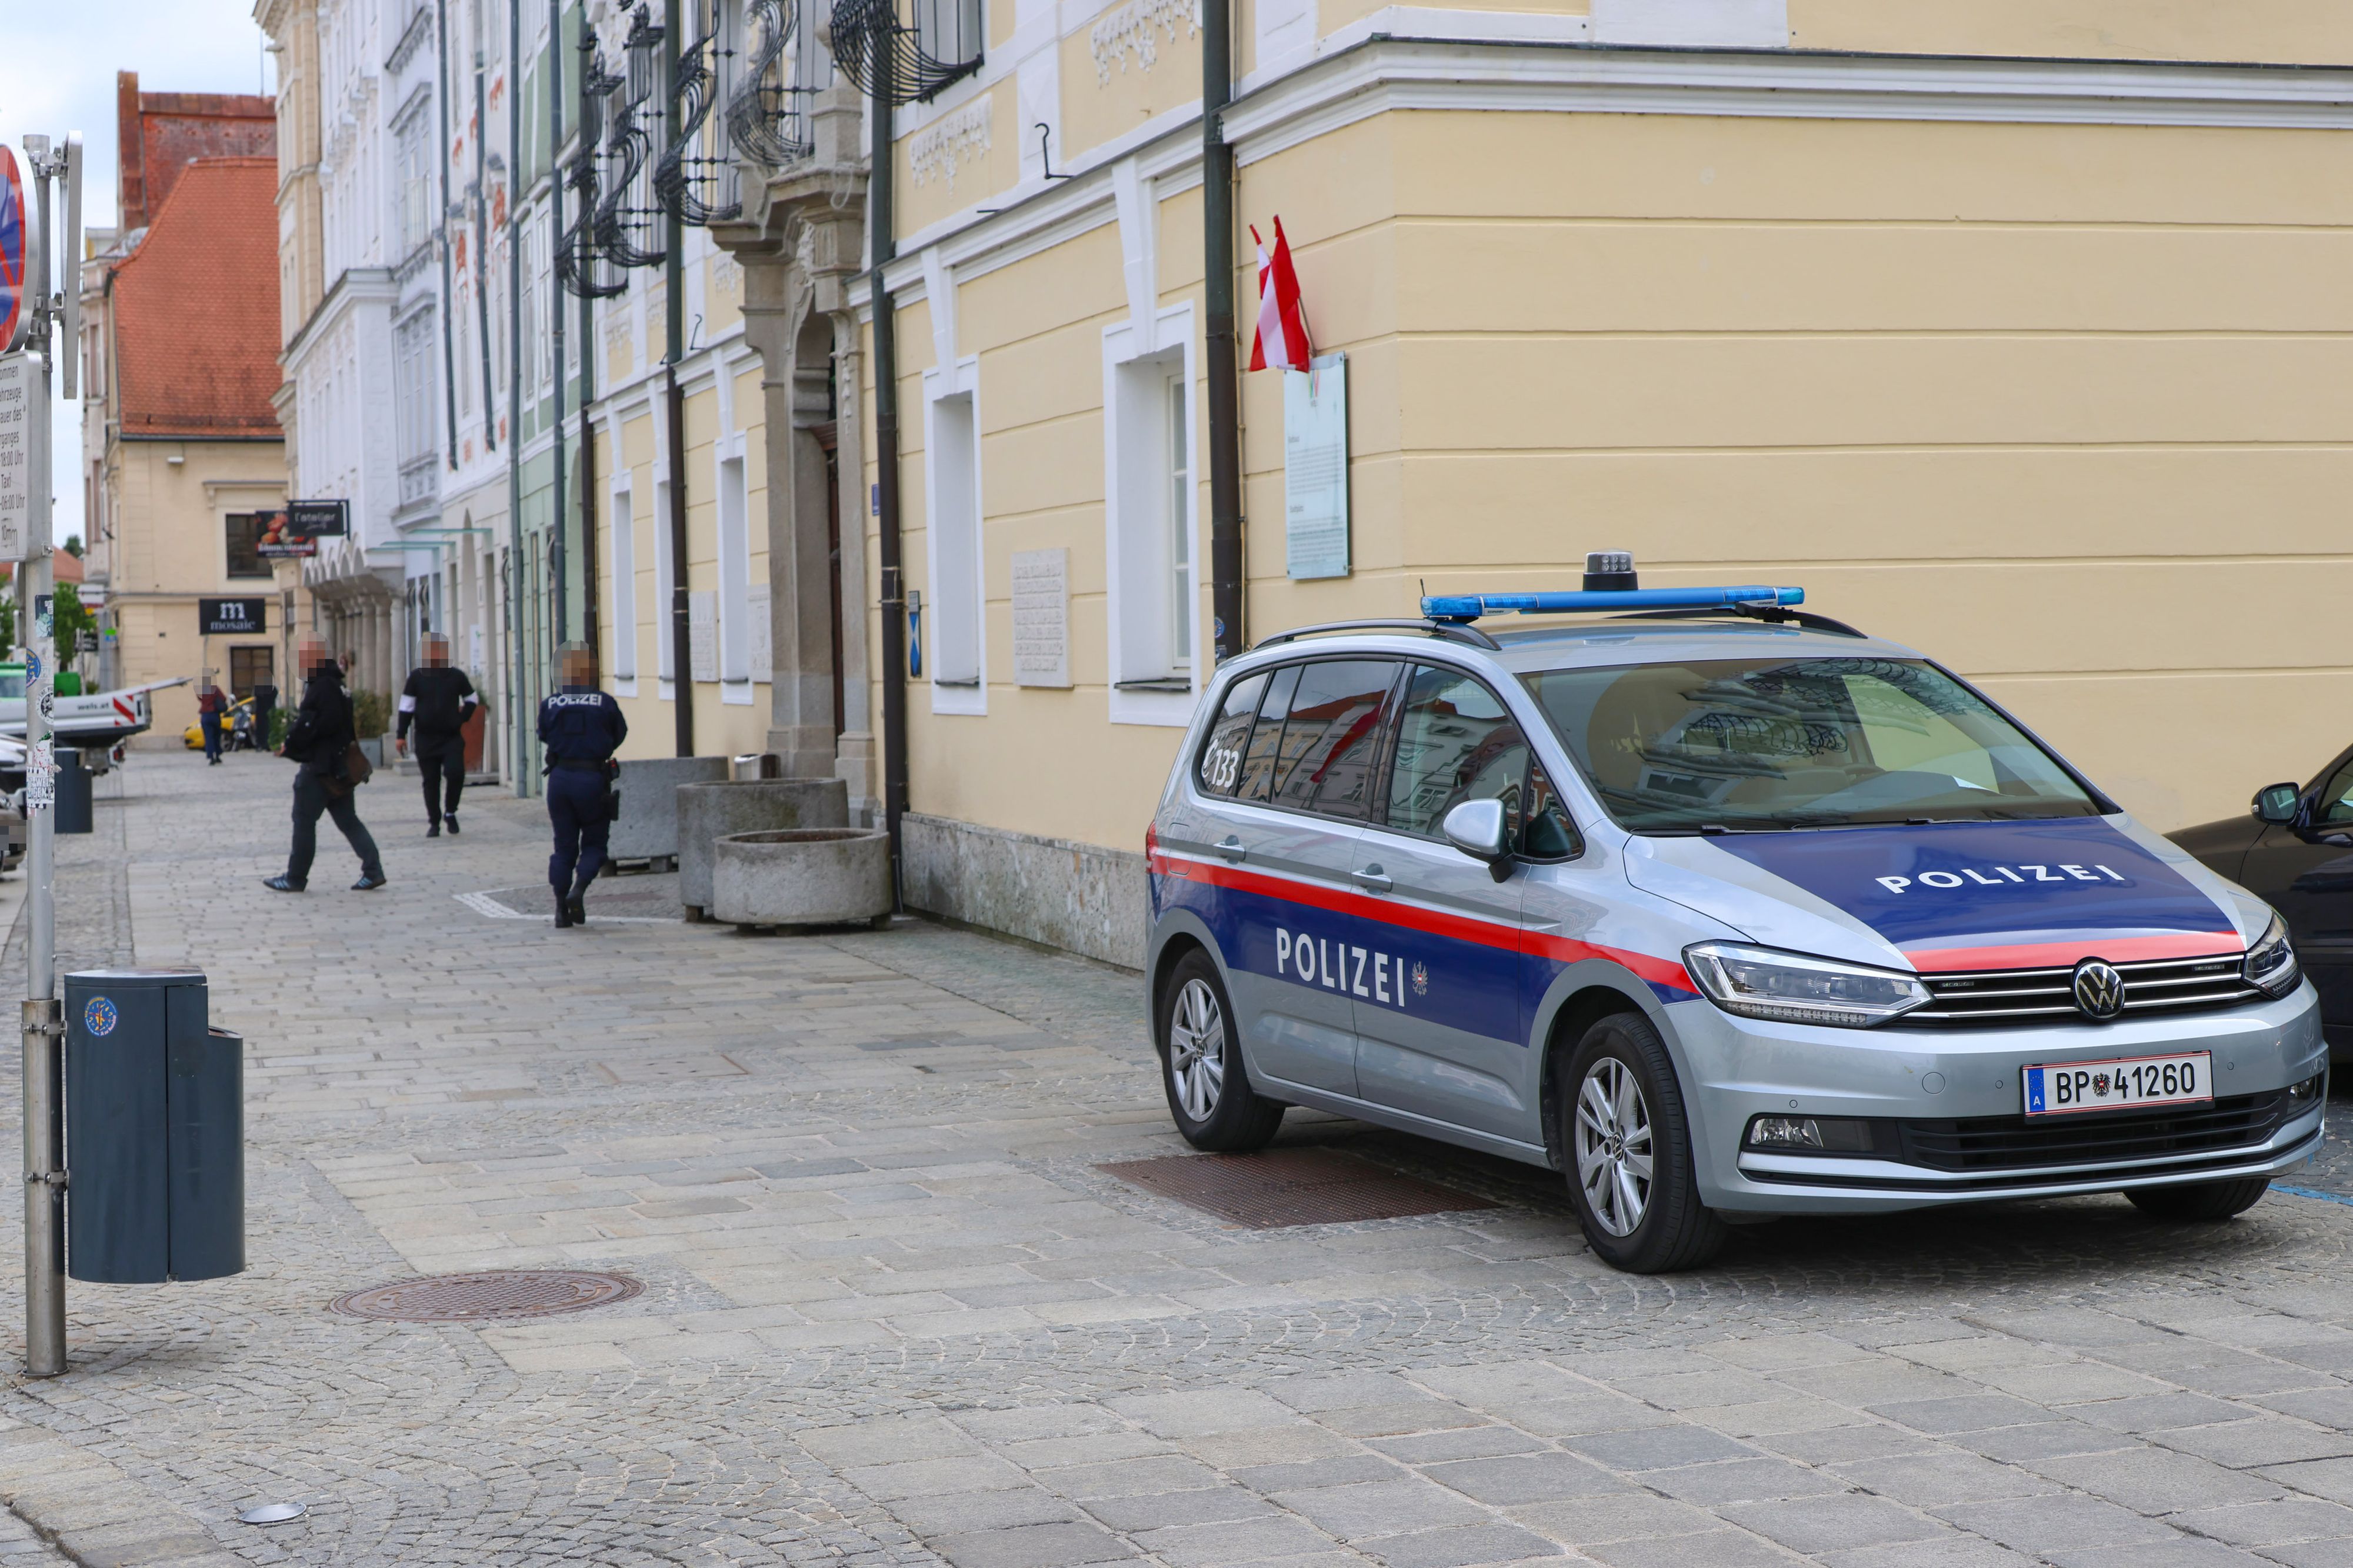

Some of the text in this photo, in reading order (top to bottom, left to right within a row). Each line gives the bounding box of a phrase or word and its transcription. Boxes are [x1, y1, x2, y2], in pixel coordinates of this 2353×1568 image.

[13, 406, 22, 421] des
[0, 449, 24, 467] 18:00 Uhr
[1, 472, 11, 489] Taxi
[16, 493, 25, 509] Uhr
[219, 602, 245, 619] m
[210, 619, 256, 630] mosaic
[1212, 748, 1239, 788] 133
[1875, 865, 2125, 894] POLIZEI
[1276, 927, 1405, 1007] POLIZEI
[2033, 1062, 2195, 1106] A BP 41260
